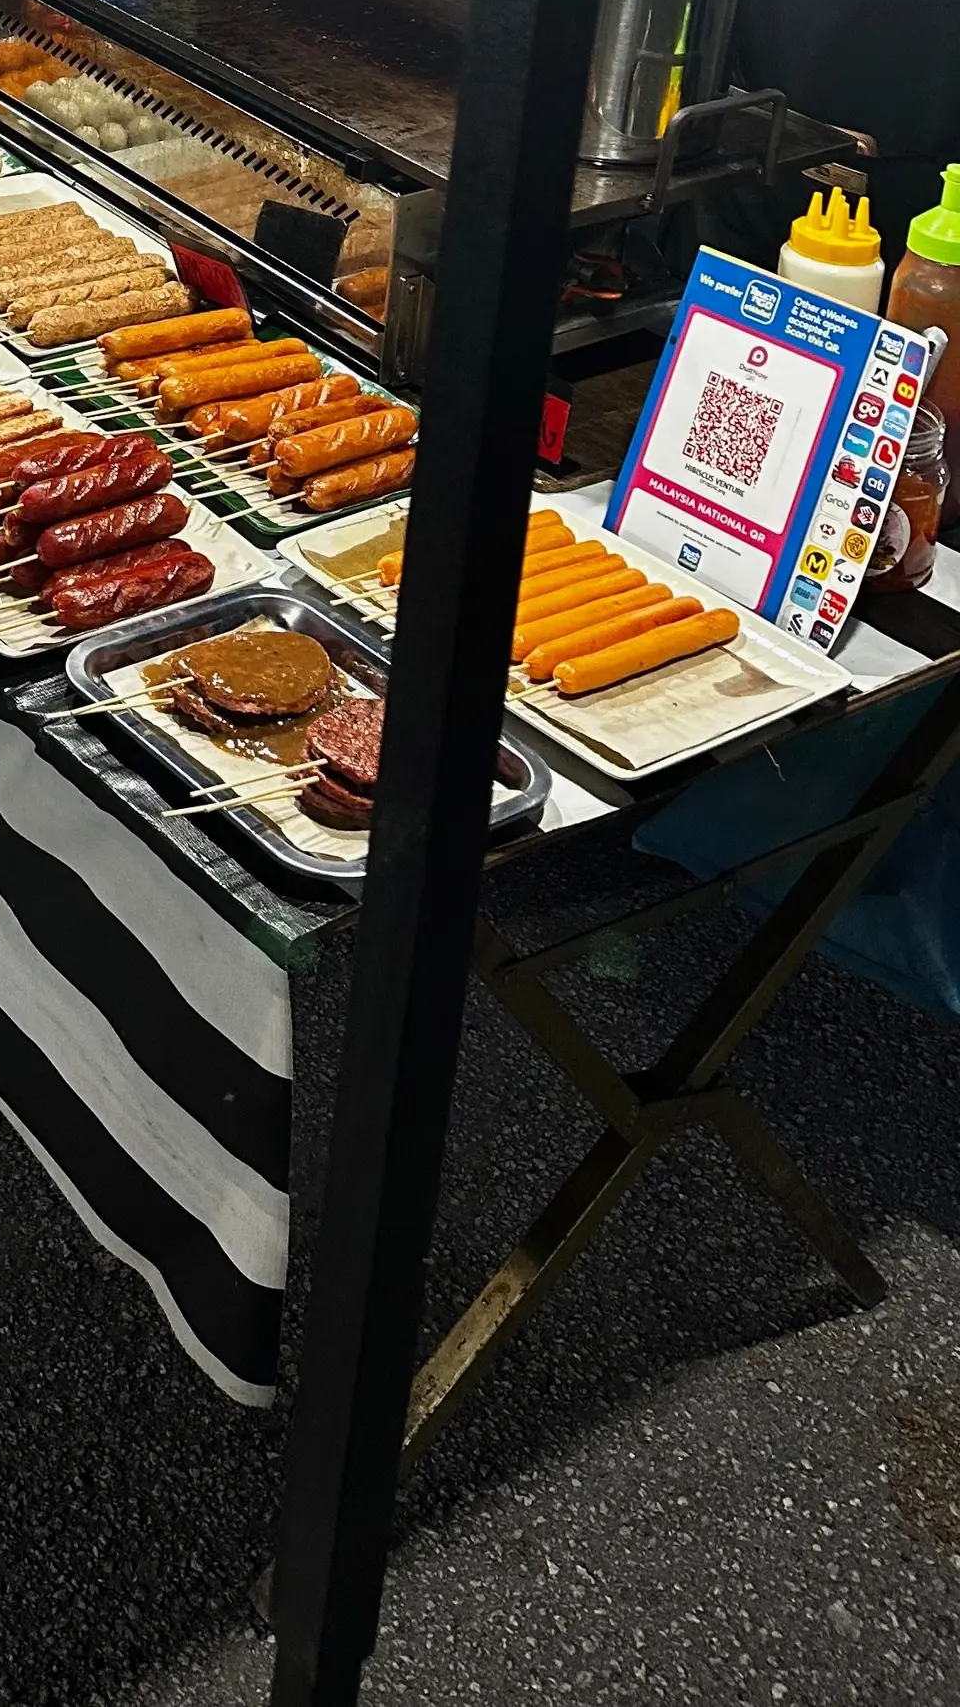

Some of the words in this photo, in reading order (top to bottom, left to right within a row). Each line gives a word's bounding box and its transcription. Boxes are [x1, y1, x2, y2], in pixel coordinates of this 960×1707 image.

[700, 272, 716, 287] We
[714, 281, 744, 299] prefer
[750, 284, 777, 304] Touch
[794, 296, 820, 313] Other
[820, 308, 858, 330] eWallets
[799, 308, 822, 325] bank
[822, 319, 846, 335] apps
[784, 324, 807, 341] Scan
[807, 334, 824, 347] this
[685, 463, 715, 483] HIBISCUS
[715, 478, 746, 499] VENTURE
[648, 477, 697, 510] MALAYSIA
[697, 502, 748, 536] NATIONAL
[748, 529, 767, 545] QR
[825, 493, 850, 511] Grab
[820, 599, 843, 623] Pay
